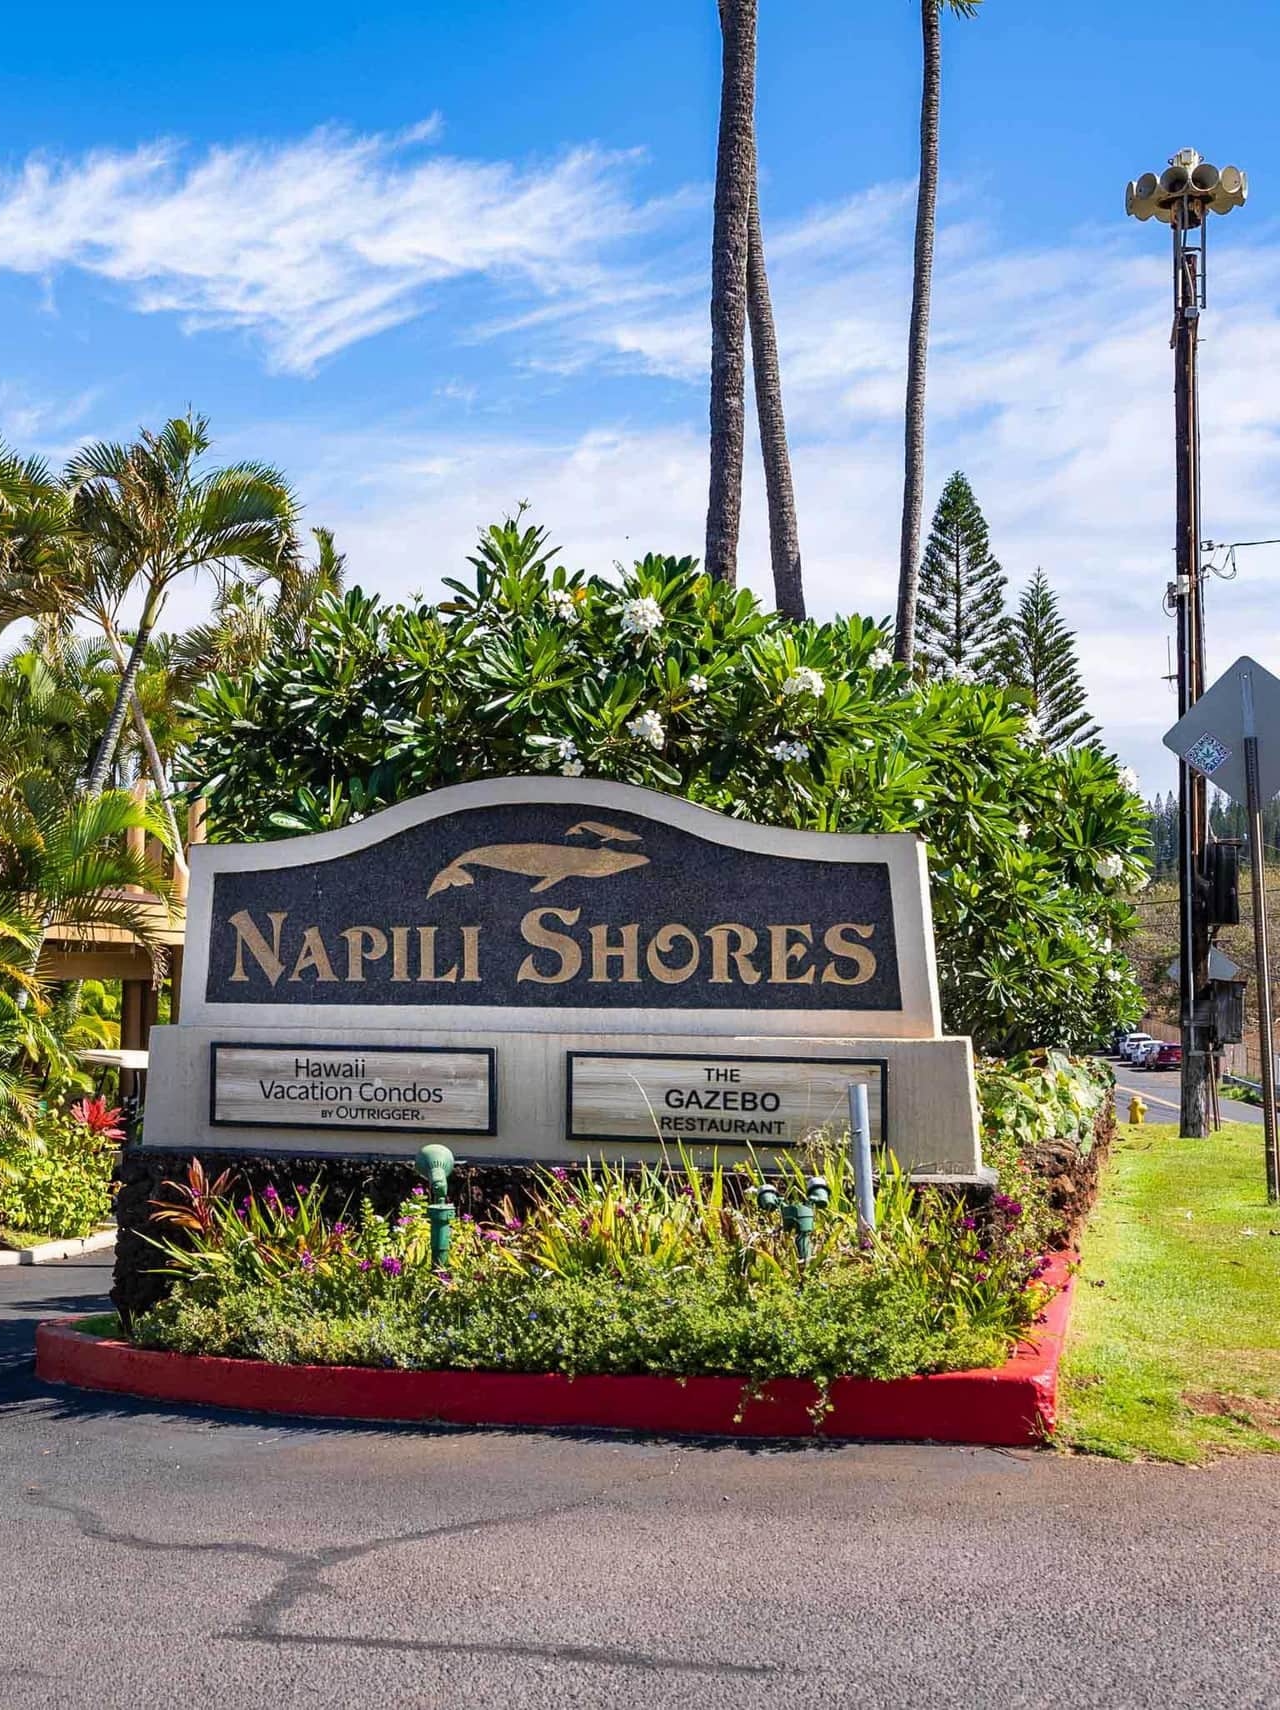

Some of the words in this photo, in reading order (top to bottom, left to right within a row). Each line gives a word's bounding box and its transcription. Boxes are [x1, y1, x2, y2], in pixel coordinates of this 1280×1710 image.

[227, 909, 482, 987] NAPILI
[516, 906, 877, 985] SHORES
[294, 1057, 366, 1078] Hawaii
[703, 1067, 741, 1083] THE
[259, 1080, 352, 1101] Vacation
[359, 1082, 444, 1103] Condos
[664, 1088, 781, 1112] GAZEBO
[321, 1109, 333, 1118] BY
[660, 1116, 786, 1135] RESTAURANT
